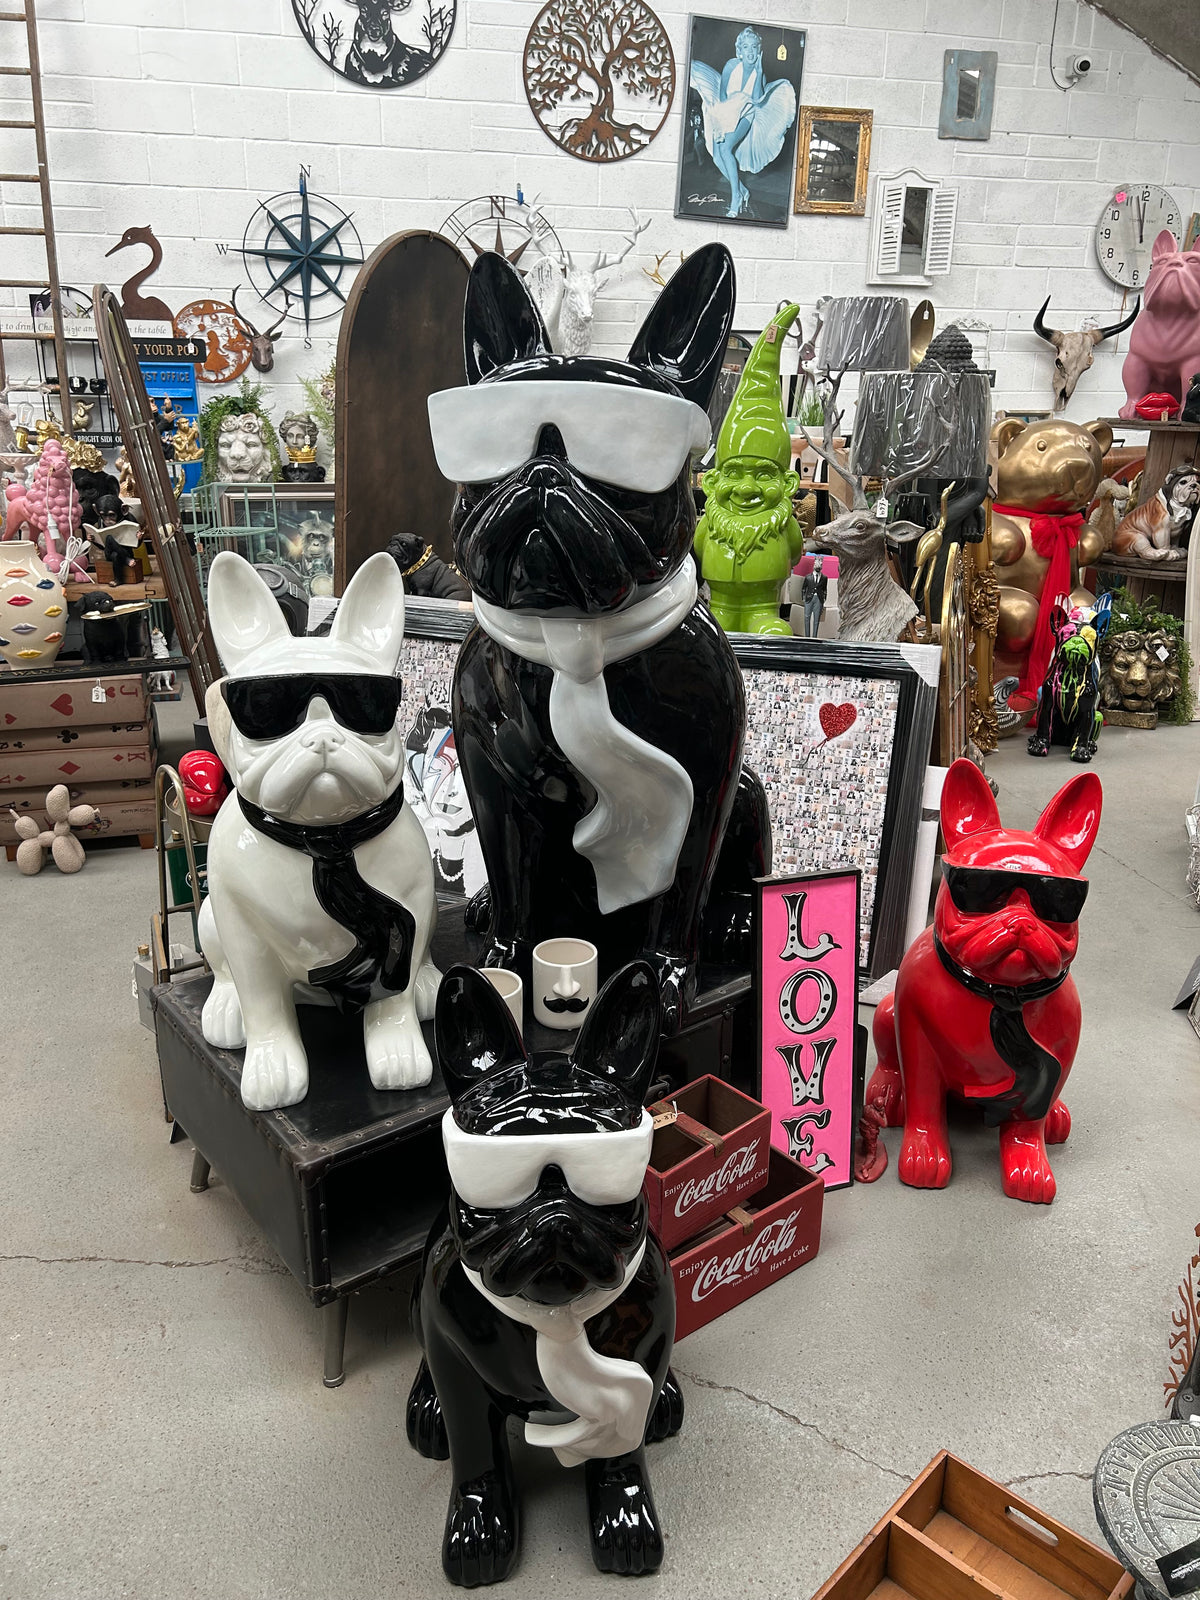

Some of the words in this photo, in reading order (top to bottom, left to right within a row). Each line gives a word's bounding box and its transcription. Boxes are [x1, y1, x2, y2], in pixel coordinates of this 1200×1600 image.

[1141, 190, 1151, 202] 12
[1111, 209, 1120, 221] 10
[1166, 213, 1174, 225] 2
[1104, 228, 1111, 240] 9
[1107, 247, 1114, 259] 8
[1117, 262, 1125, 273] 7
[1132, 269, 1139, 281] 6
[5, 323, 14, 331] to
[134, 324, 147, 334] the
[148, 325, 167, 335] table
[143, 344, 175, 356] YOUR
[160, 371, 191, 383] OFFICE
[11, 667, 74, 676] WANNA
[119, 684, 139, 697] J
[127, 751, 147, 762] K
[775, 891, 843, 1174] LOVE
[674, 1137, 761, 1218] Coca-Cola
[736, 1180, 750, 1192] Have
[755, 1167, 768, 1180] Coke
[664, 1181, 685, 1198] Enjoy
[691, 1207, 803, 1303] Coca-Cola
[769, 1258, 787, 1272] Have
[792, 1244, 810, 1259] Coke
[679, 1258, 706, 1278] Enjoy
